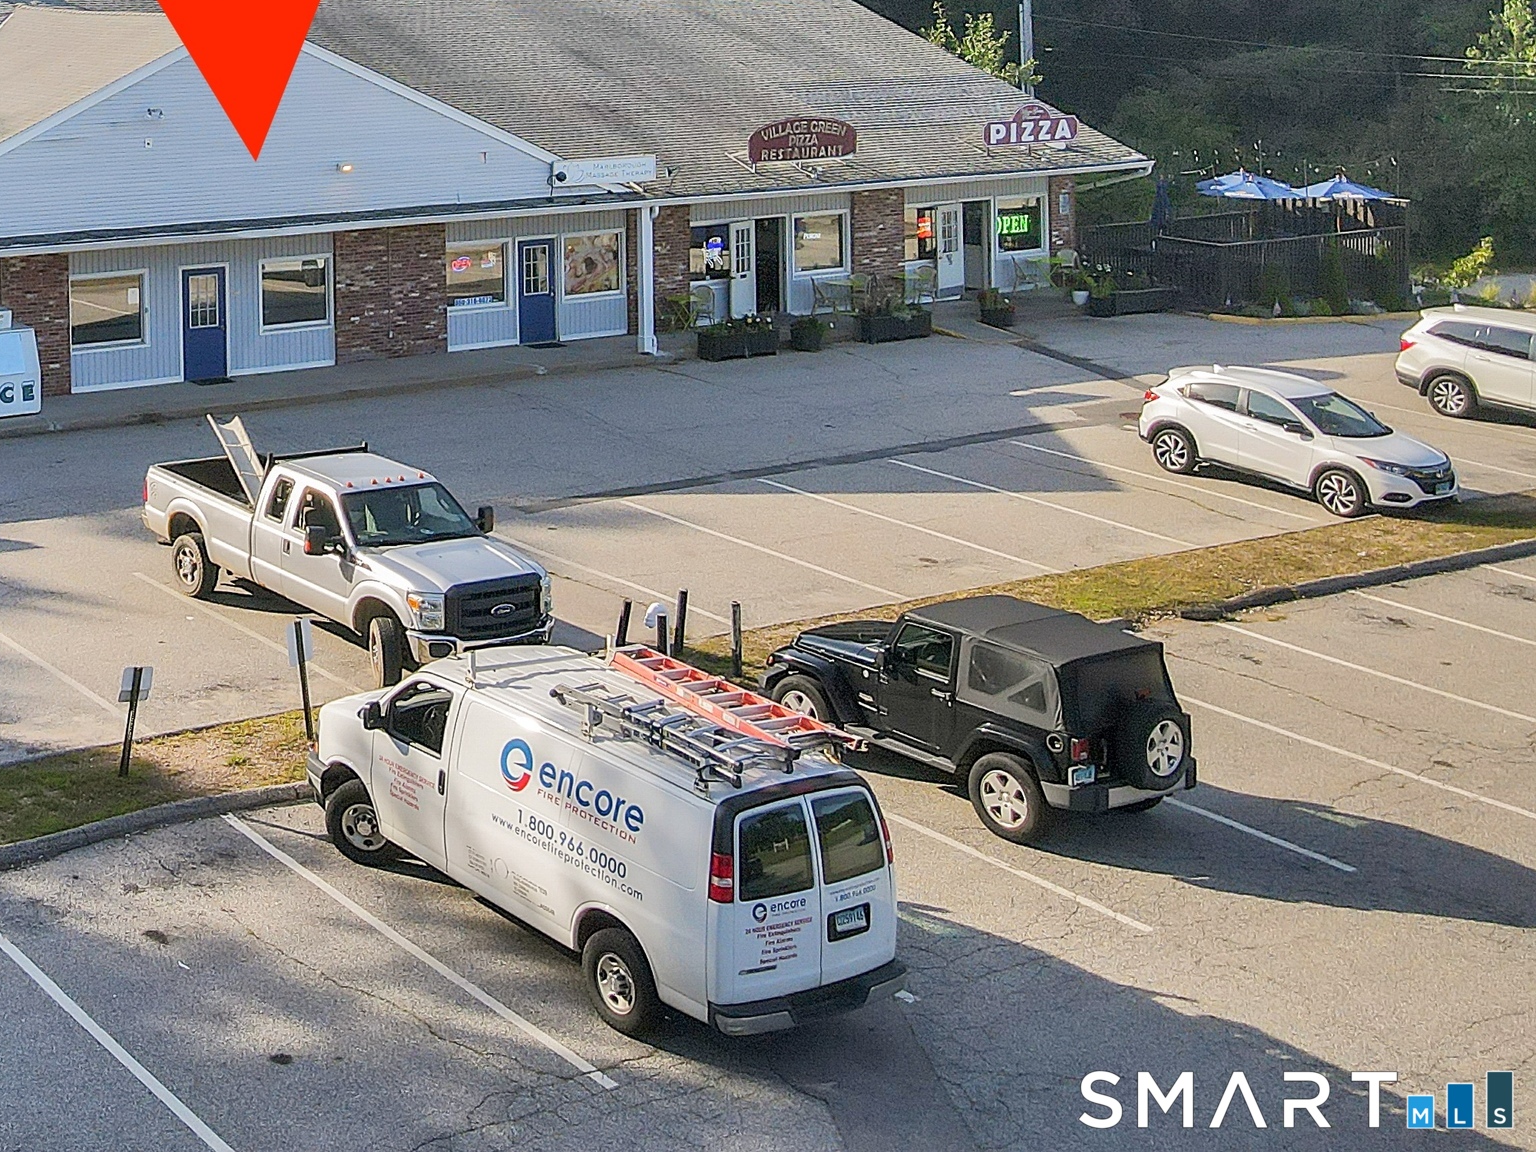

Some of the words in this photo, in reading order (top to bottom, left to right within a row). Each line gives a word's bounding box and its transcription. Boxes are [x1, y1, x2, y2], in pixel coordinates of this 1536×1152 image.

[761, 121, 807, 141] VILLAGE
[810, 121, 847, 136] GREEN
[788, 134, 819, 147] PIZZA
[990, 119, 1072, 144] PIZZA
[761, 145, 844, 160] RESTAURANT
[539, 762, 644, 833] encore
[537, 788, 561, 807] FIRE
[565, 802, 637, 845] PROTECTION
[518, 809, 627, 879] 1.800.966.0000
[491, 813, 644, 901] www.encorefireprotection.com
[770, 898, 807, 913] encore
